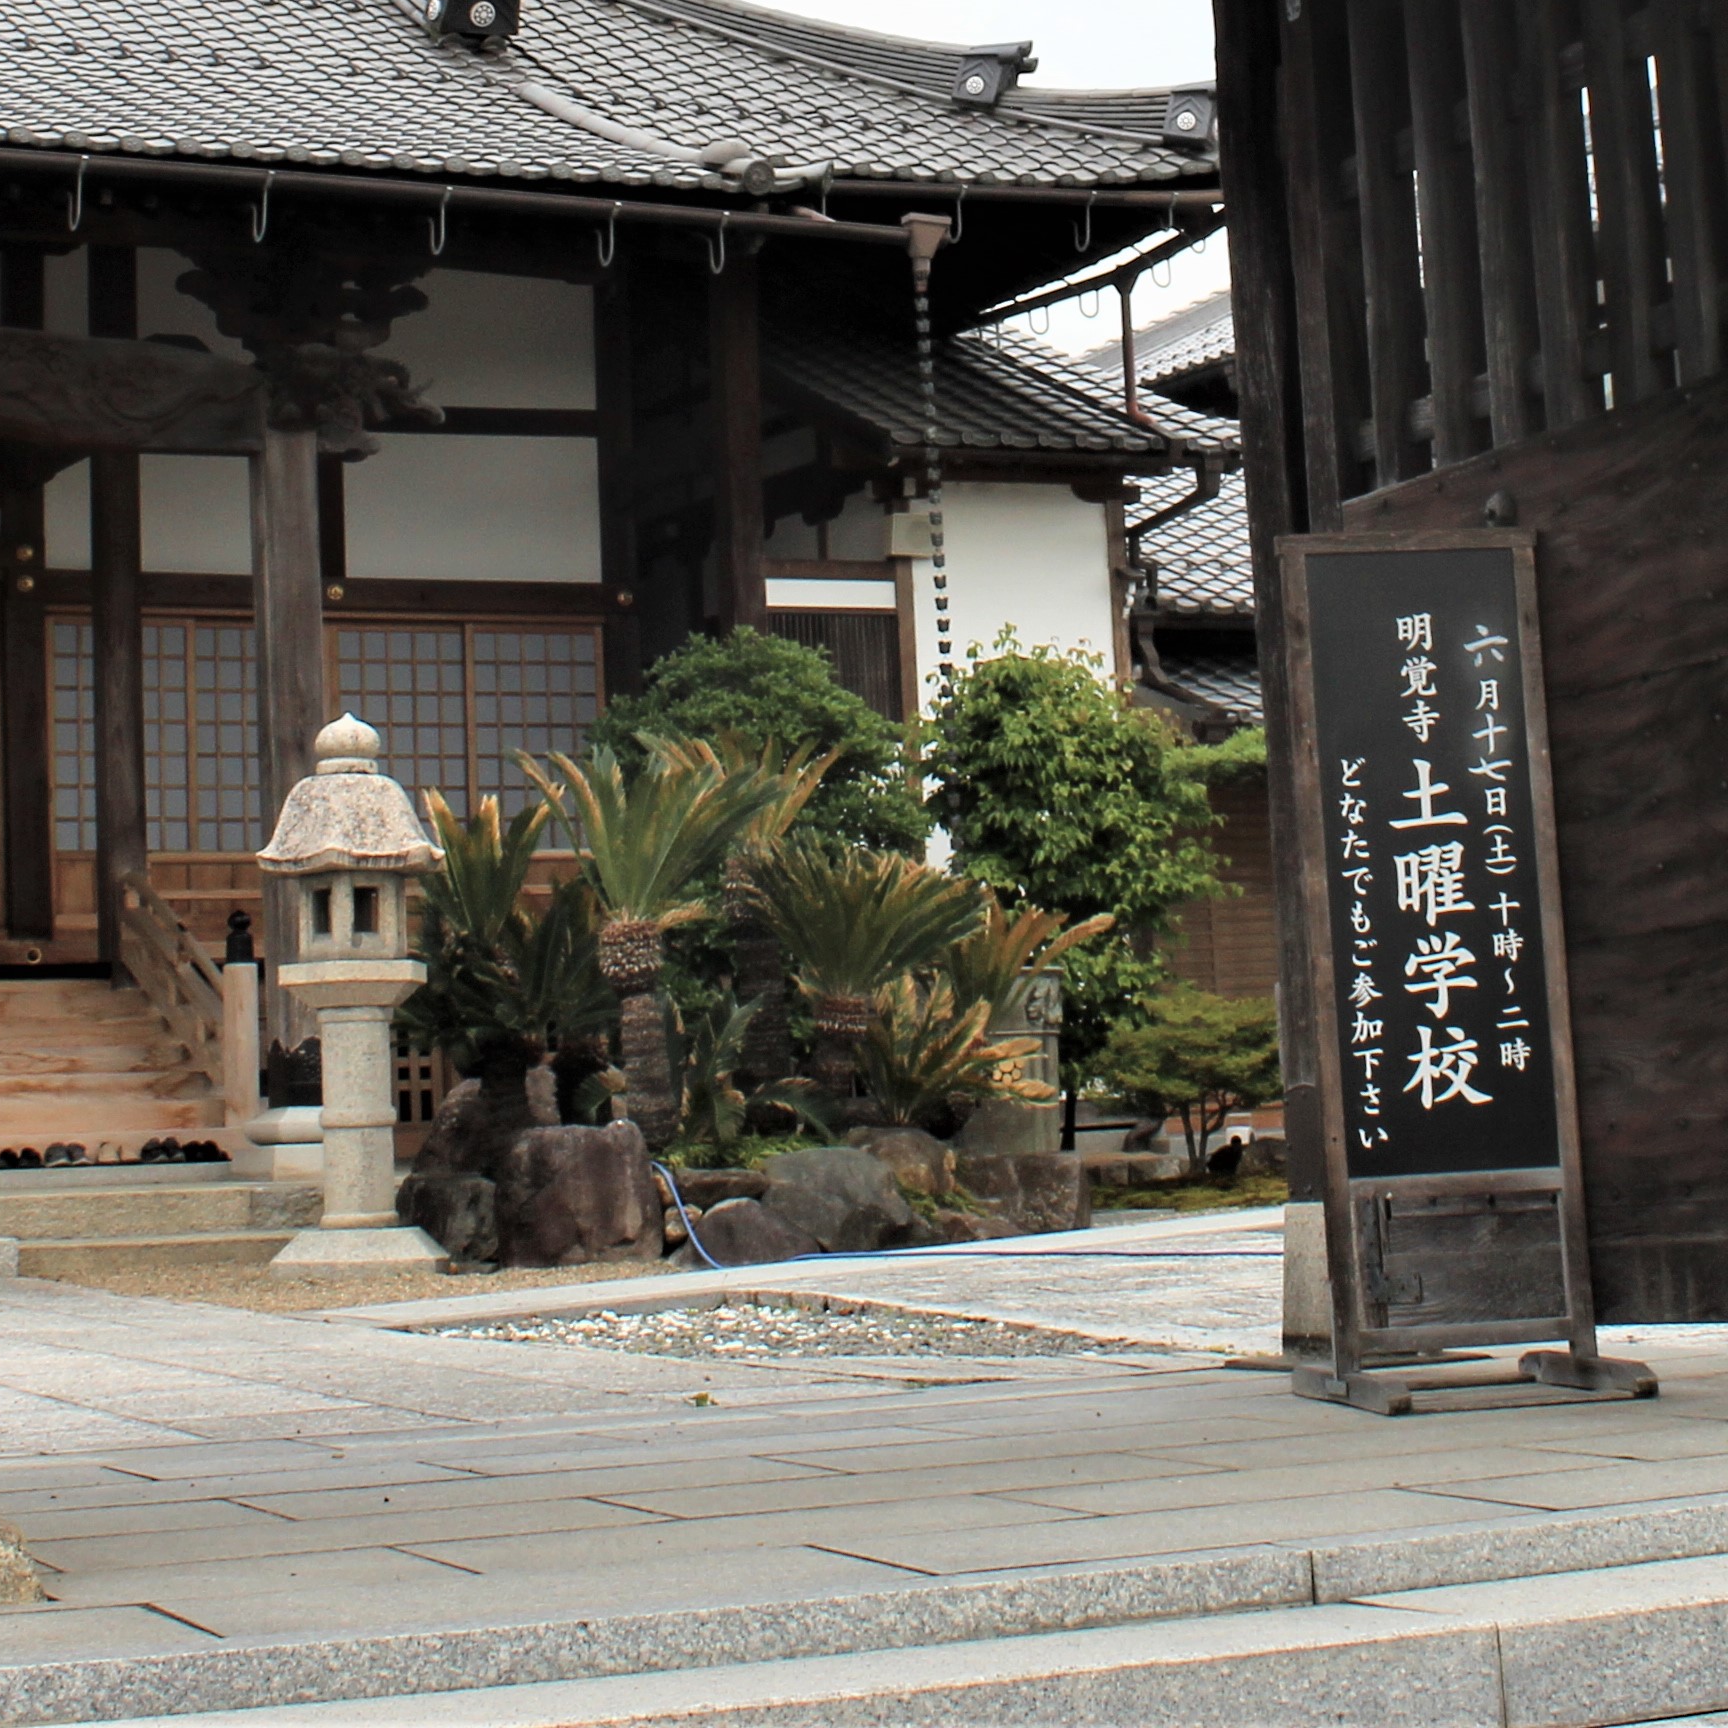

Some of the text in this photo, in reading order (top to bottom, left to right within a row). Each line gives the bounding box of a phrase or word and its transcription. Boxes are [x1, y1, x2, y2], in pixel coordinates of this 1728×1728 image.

[1339, 758, 1390, 1149] どなたでもご参加下さい
[1388, 613, 1493, 1109] 明覚寺 土曜学校
